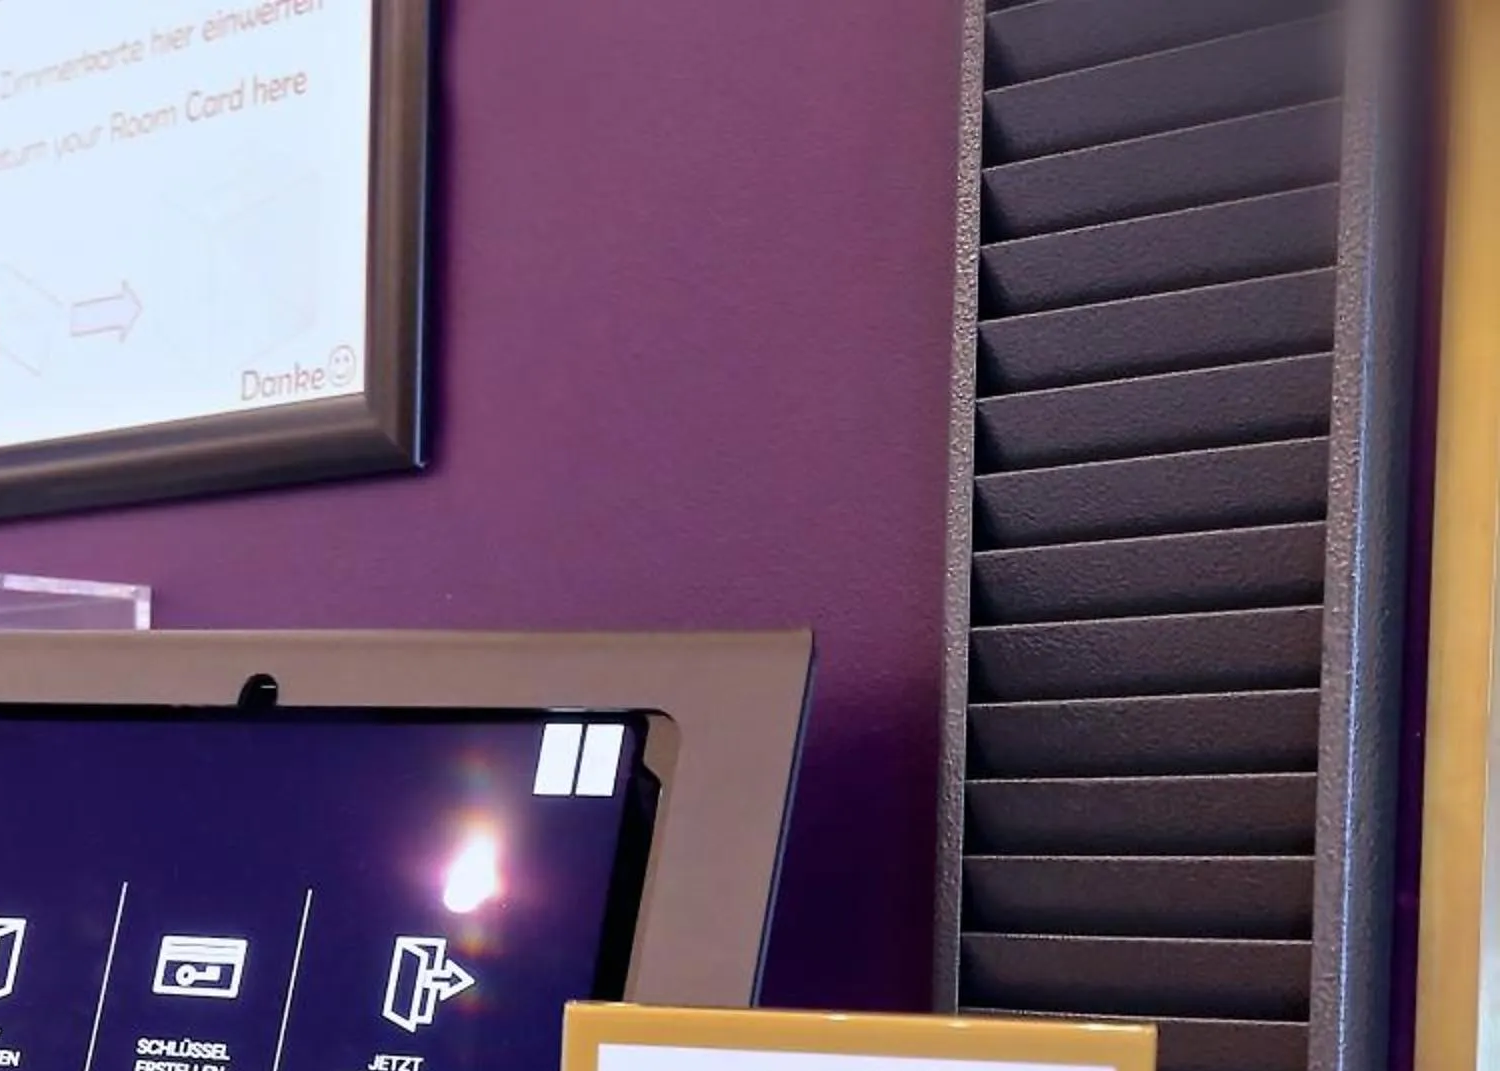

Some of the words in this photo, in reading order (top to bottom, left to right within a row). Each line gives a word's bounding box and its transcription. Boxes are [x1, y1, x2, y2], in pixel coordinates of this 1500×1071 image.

[54, 124, 104, 166] your
[110, 104, 177, 143] Room
[185, 77, 245, 122] Card
[252, 70, 308, 108] here
[240, 361, 325, 401] Danke
[136, 1036, 231, 1061] SCHLÜSSEL
